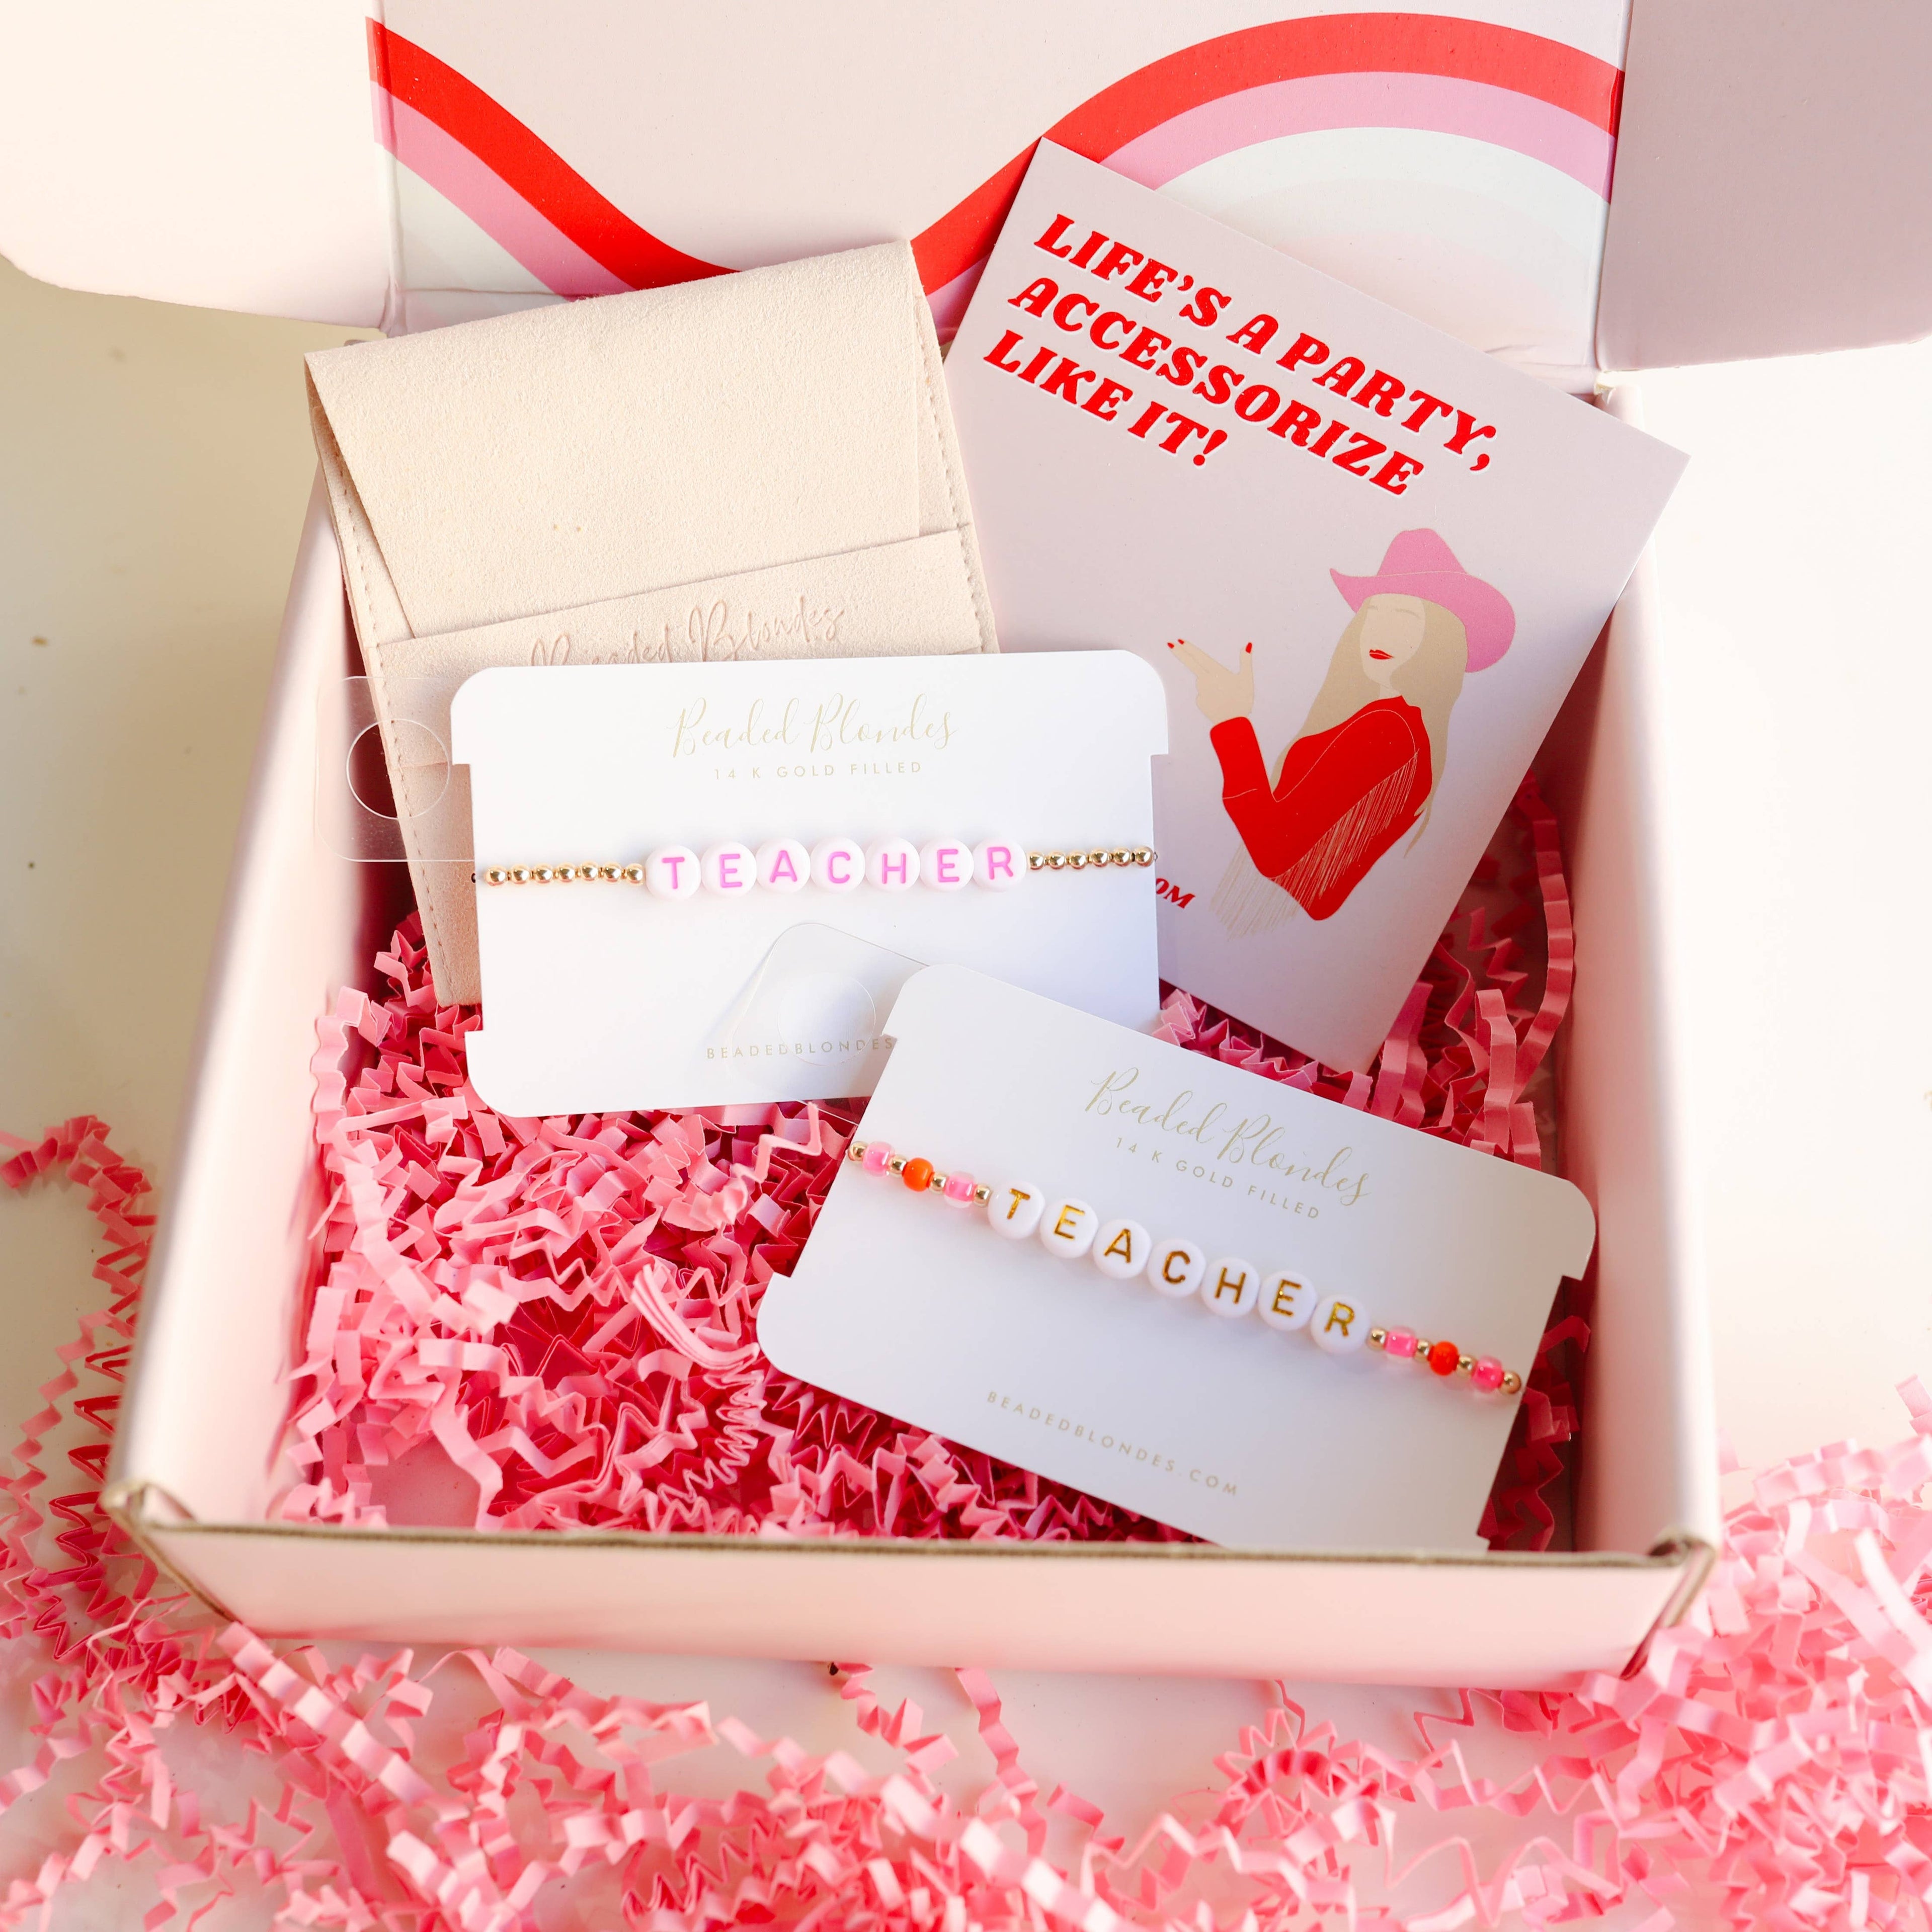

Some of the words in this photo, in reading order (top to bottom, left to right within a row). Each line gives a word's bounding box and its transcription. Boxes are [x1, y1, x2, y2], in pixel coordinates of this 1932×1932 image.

[1007, 277, 1425, 496] ACCESSORIZE
[1033, 213, 1232, 327] LIFE'S
[1227, 313, 1279, 355] A
[1277, 333, 1497, 472] PARTY,
[983, 329, 1134, 423] LIKE
[1128, 400, 1229, 467] IT!
[667, 697, 800, 758] Beaded
[804, 693, 957, 753] Blondes
[714, 768, 737, 780] 14
[751, 767, 762, 779] K
[776, 764, 835, 778] GOLD
[850, 761, 922, 775] FILLED
[662, 845, 1015, 891] TEACHER
[707, 1037, 893, 1059] BEADEDBLONDES
[1084, 1067, 1228, 1145] Beaded
[1217, 1114, 1372, 1206] Blondes
[1115, 1137, 1138, 1154] 14
[1151, 1150, 1163, 1163] K
[1176, 1160, 1234, 1189] GOLD
[1248, 1185, 1320, 1220] FILLED
[1006, 1187, 1356, 1337] TEACHER
[987, 1391, 1238, 1496] BEADEDBLONDES.COM
